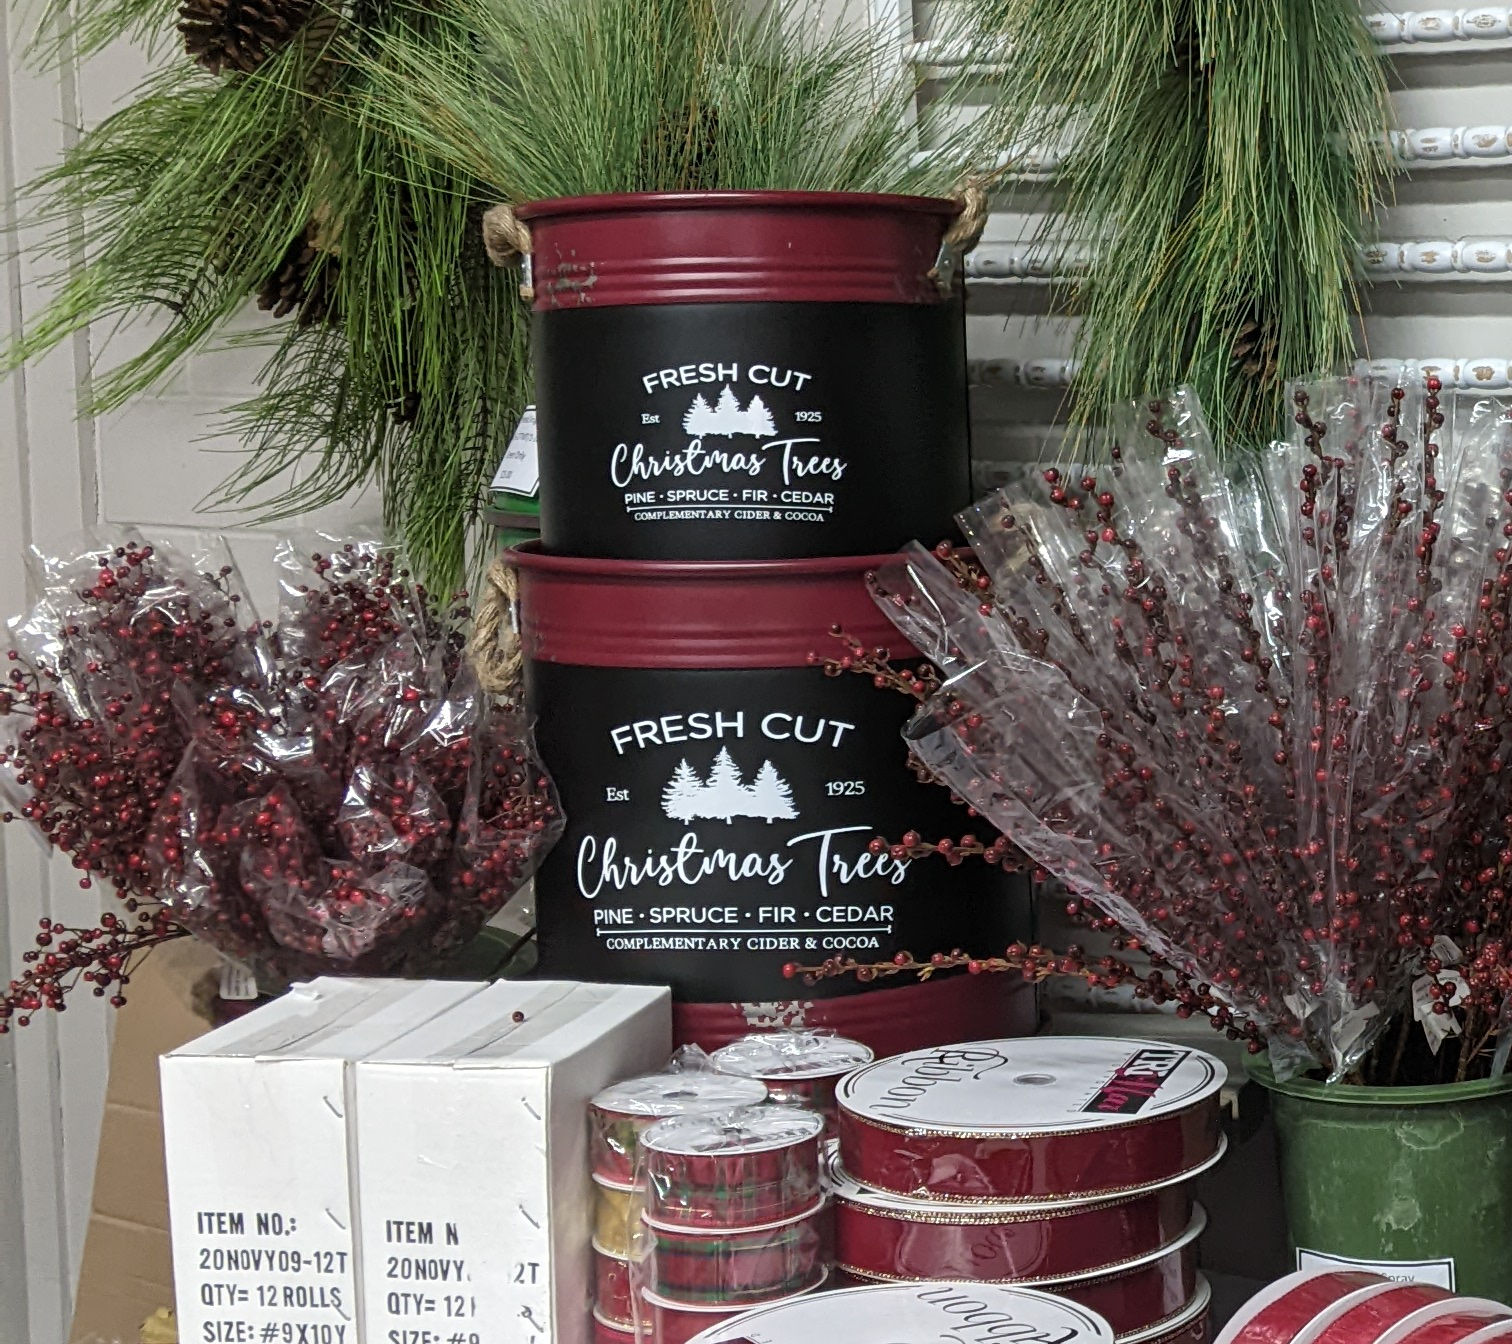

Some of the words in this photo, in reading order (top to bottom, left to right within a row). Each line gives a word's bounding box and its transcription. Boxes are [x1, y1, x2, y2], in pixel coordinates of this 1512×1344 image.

[642, 362, 738, 394] FRESH
[748, 364, 812, 391] CUT
[641, 413, 661, 424] Est
[795, 411, 822, 422] 1925
[610, 438, 767, 488] Christmas
[761, 438, 848, 485] Trees
[624, 491, 656, 504] PINE
[666, 489, 729, 502] SPRUCE
[742, 489, 768, 502] FIR
[780, 490, 835, 505] CEDAR
[634, 510, 731, 521] COMPLEMENTARY
[734, 510, 771, 520] CIDER
[772, 511, 782, 520] &
[785, 512, 825, 522] COCOA
[610, 711, 744, 755] FRESH
[761, 712, 855, 748] CUT
[606, 787, 630, 802] Est
[824, 781, 866, 796] 1925
[577, 832, 794, 899] Christmas
[786, 825, 912, 898] Trees
[594, 909, 634, 925] PINE
[650, 907, 739, 924] SPRUCE
[759, 906, 797, 923] FIR
[816, 905, 894, 922] CEDAR
[606, 937, 741, 950] COMPLEMENTARY
[747, 937, 800, 950] CIDER
[804, 937, 817, 949] &
[822, 936, 880, 949] COCOA
[868, 1047, 1008, 1110] Ribbon
[197, 1211, 245, 1235] ITEM
[257, 1212, 297, 1236] NO.:
[386, 1220, 433, 1244] ITEM
[199, 1248, 347, 1274] 20NOVY09-12T
[201, 1284, 249, 1307] QTY=
[256, 1285, 278, 1307] 12
[283, 1286, 343, 1308] ROLLS
[387, 1292, 435, 1315] QTY=
[444, 1296, 465, 1317] 12
[203, 1321, 255, 1344] SIZE:
